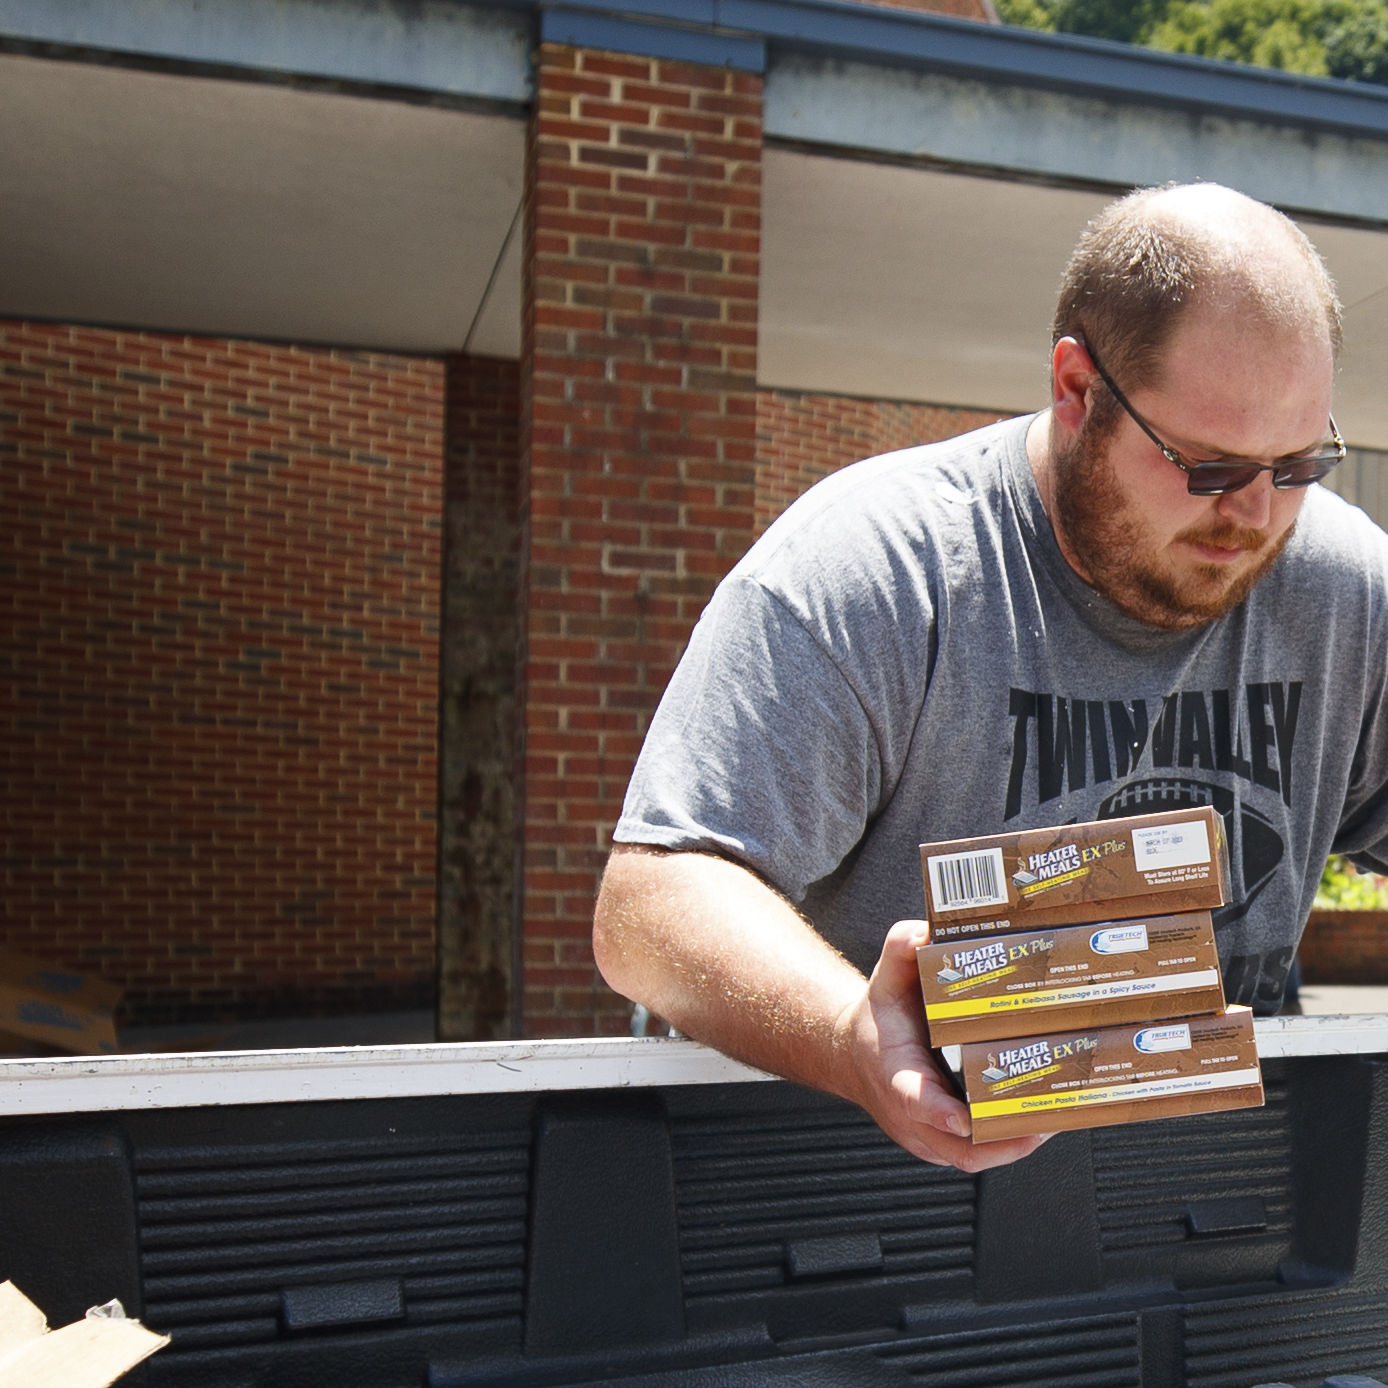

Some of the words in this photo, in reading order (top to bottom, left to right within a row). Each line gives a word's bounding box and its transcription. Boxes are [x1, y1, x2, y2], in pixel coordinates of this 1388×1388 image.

[1004, 687, 1148, 822] TWIN
[1028, 844, 1079, 871] HEATER
[1081, 845, 1102, 863] EX
[1103, 840, 1126, 856] Plus
[1037, 856, 1081, 881] MEALS
[935, 928, 945, 936] DO
[947, 927, 960, 935] NOT
[961, 924, 979, 933] OPEN
[980, 922, 995, 931] THIS
[996, 920, 1010, 929] END
[953, 942, 1005, 969] HEATER
[1008, 944, 1029, 962] EX
[1029, 938, 1054, 954] Plus
[963, 955, 1008, 979] MEALS
[1058, 990, 1091, 1000] Sausage
[1109, 985, 1130, 996] Spicy
[1132, 982, 1156, 991] Sauce
[998, 1041, 1049, 1067] HEATER
[1053, 1042, 1074, 1060] EX
[1074, 1037, 1098, 1053] Plus
[1008, 1053, 1052, 1078] MEALS
[1021, 1099, 1053, 1108] Chicken
